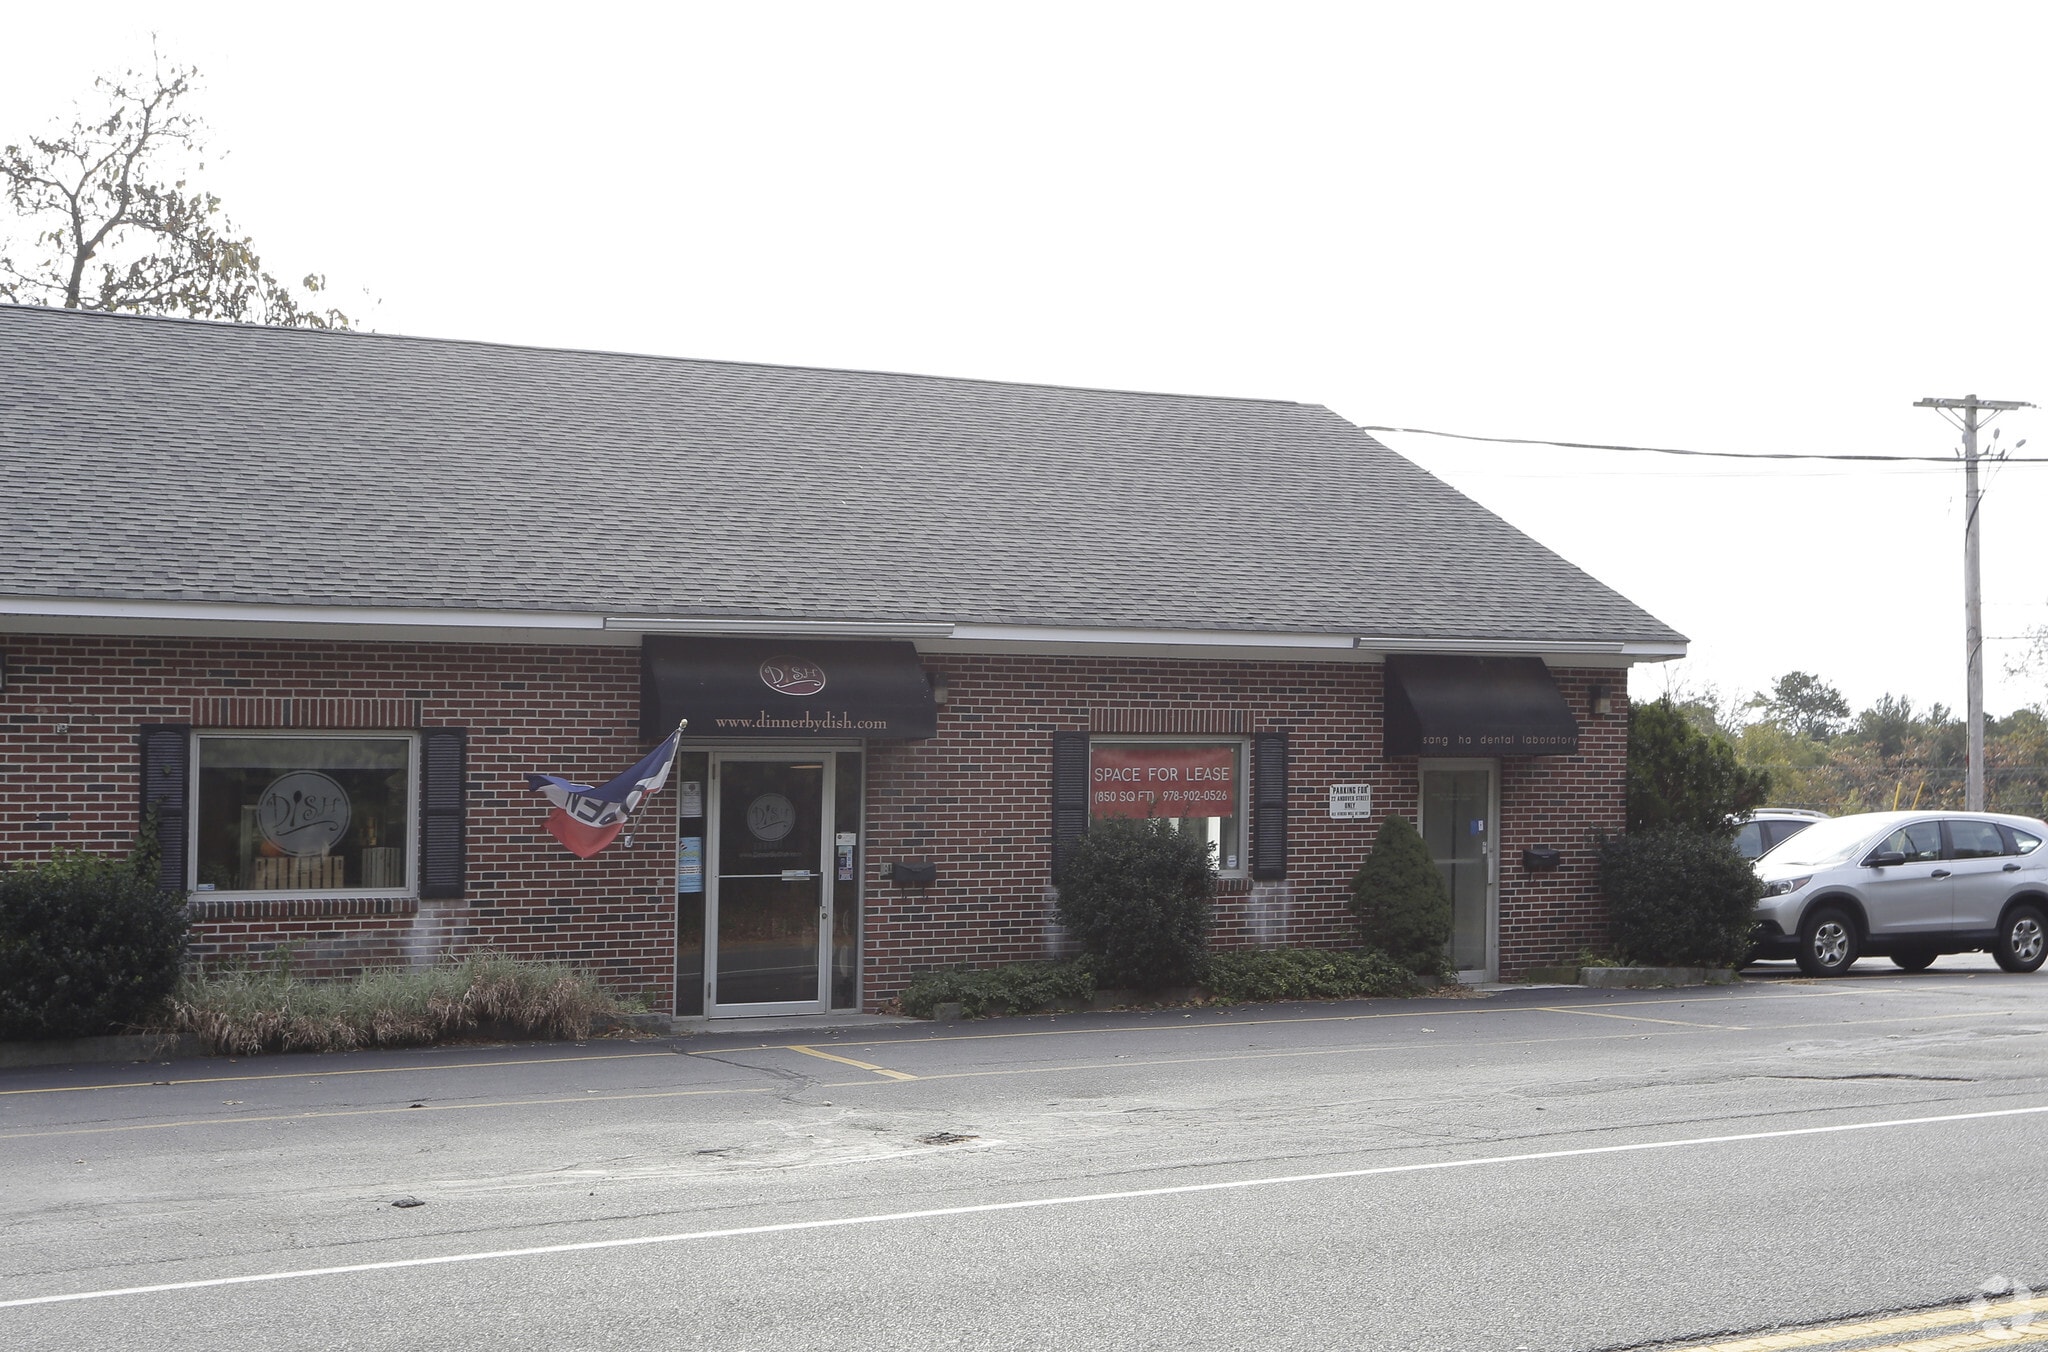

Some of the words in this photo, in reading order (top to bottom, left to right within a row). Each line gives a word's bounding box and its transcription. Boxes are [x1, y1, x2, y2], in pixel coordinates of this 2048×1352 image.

[715, 710, 888, 732] www.dinnerbydish.com
[1423, 736, 1449, 747] sang
[1458, 735, 1472, 745] ha
[1480, 735, 1515, 745] dental
[1522, 735, 1578, 747] laboratory
[1094, 767, 1141, 782] SPACE
[1148, 767, 1178, 782] FOR
[1186, 767, 1230, 781] LEASE
[1094, 790, 1117, 805] (850
[1119, 791, 1136, 802] SQ
[1138, 790, 1155, 803] FT)
[1162, 790, 1228, 802] 978-902-0526
[1357, 786, 1367, 794] FOR
